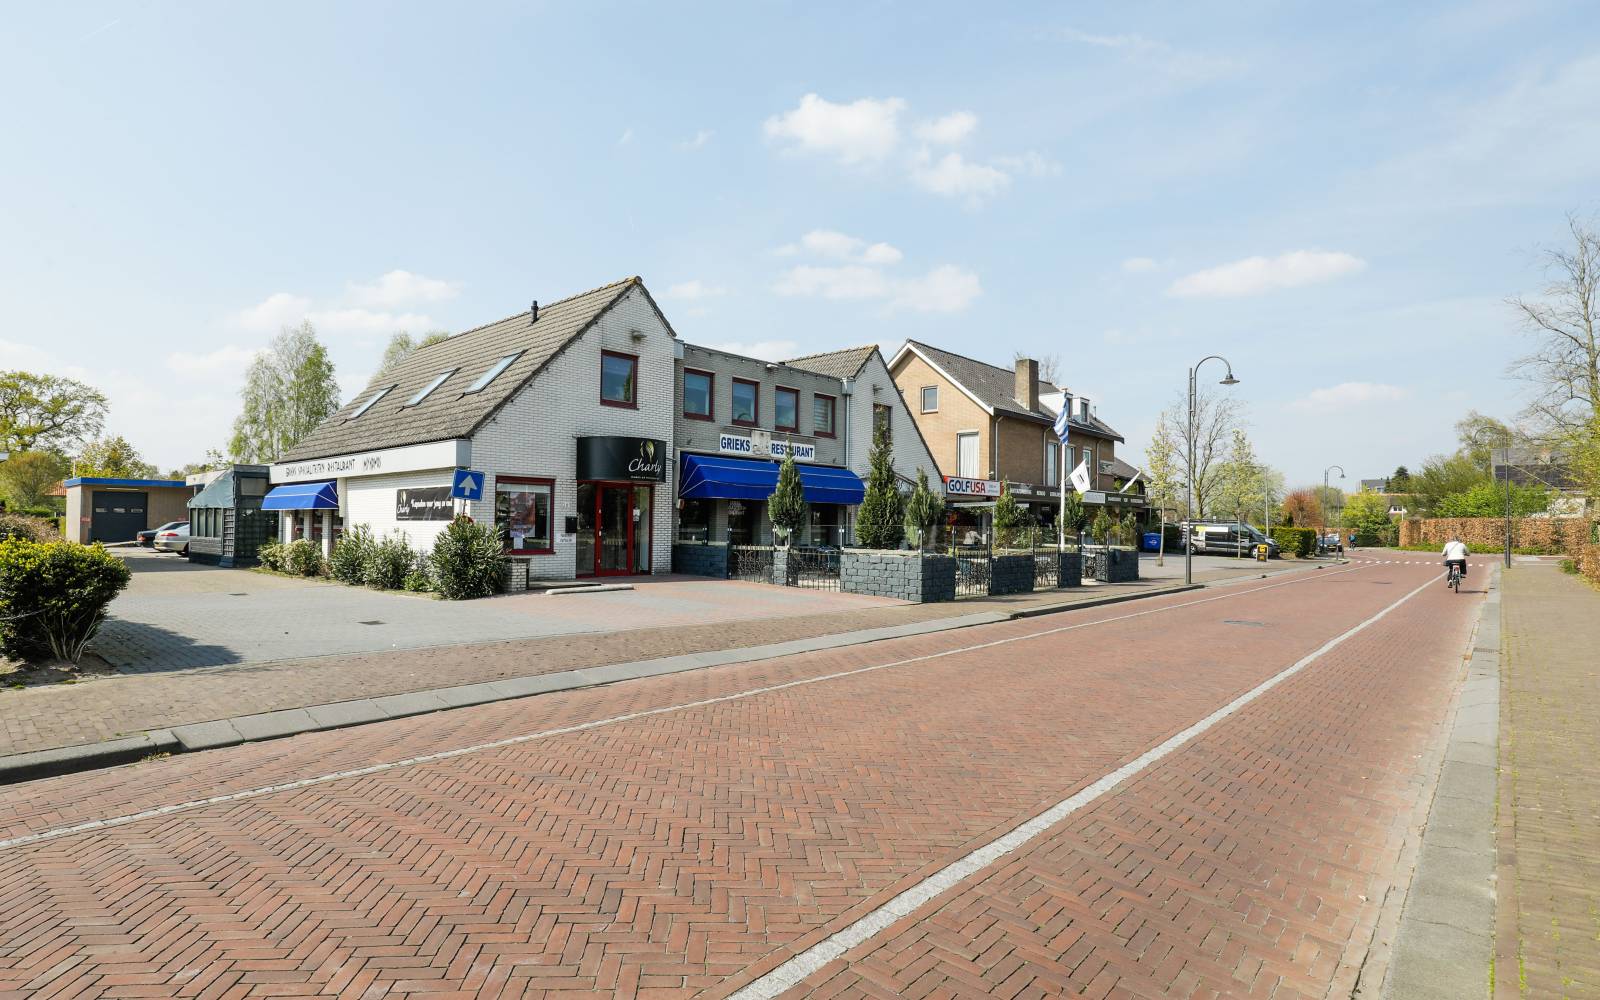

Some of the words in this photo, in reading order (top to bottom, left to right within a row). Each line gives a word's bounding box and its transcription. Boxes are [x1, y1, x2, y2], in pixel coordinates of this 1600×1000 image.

[720, 436, 751, 452] GRIEKS
[771, 443, 814, 458] RESURANT
[628, 457, 662, 474] Charly
